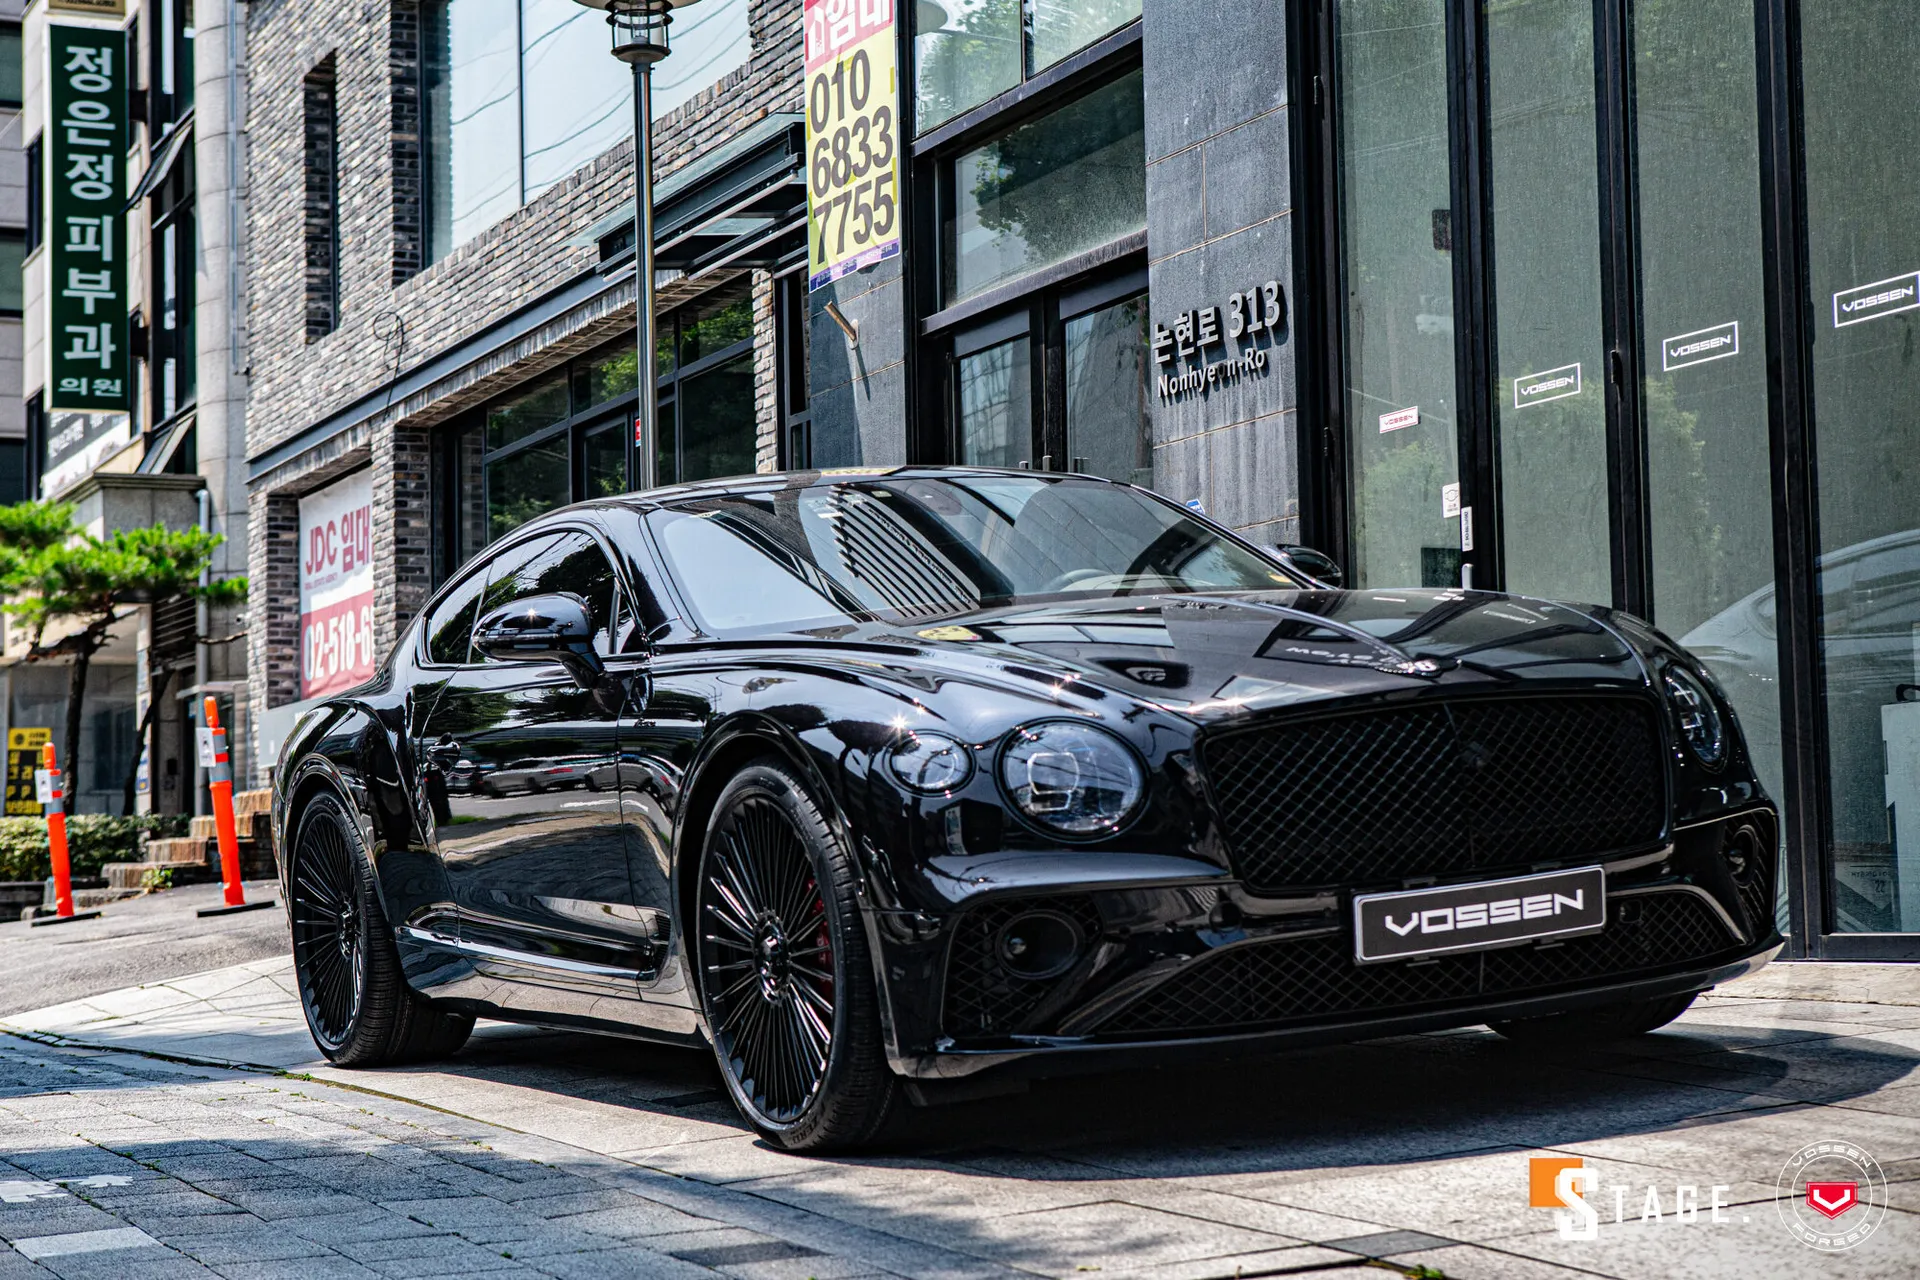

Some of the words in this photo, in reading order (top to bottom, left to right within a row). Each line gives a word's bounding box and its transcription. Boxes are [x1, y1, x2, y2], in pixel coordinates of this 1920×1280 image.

[61, 45, 116, 201] 정은정
[810, 48, 871, 134] 010
[812, 105, 893, 198] 6833
[813, 171, 895, 265] 7755
[61, 215, 116, 369] 피부과
[1152, 306, 1219, 364] 논현로
[1229, 280, 1281, 338] 313
[1842, 285, 1914, 312] VOSSEN
[1158, 347, 1266, 398] Nonhyeon-Ro
[1670, 334, 1732, 357] VOSSEN
[58, 377, 123, 397] 의원
[1520, 374, 1575, 396] VOSSEN
[305, 519, 338, 576] JDC
[303, 604, 375, 682] 02-518-6
[1384, 888, 1584, 937] VOSSEN
